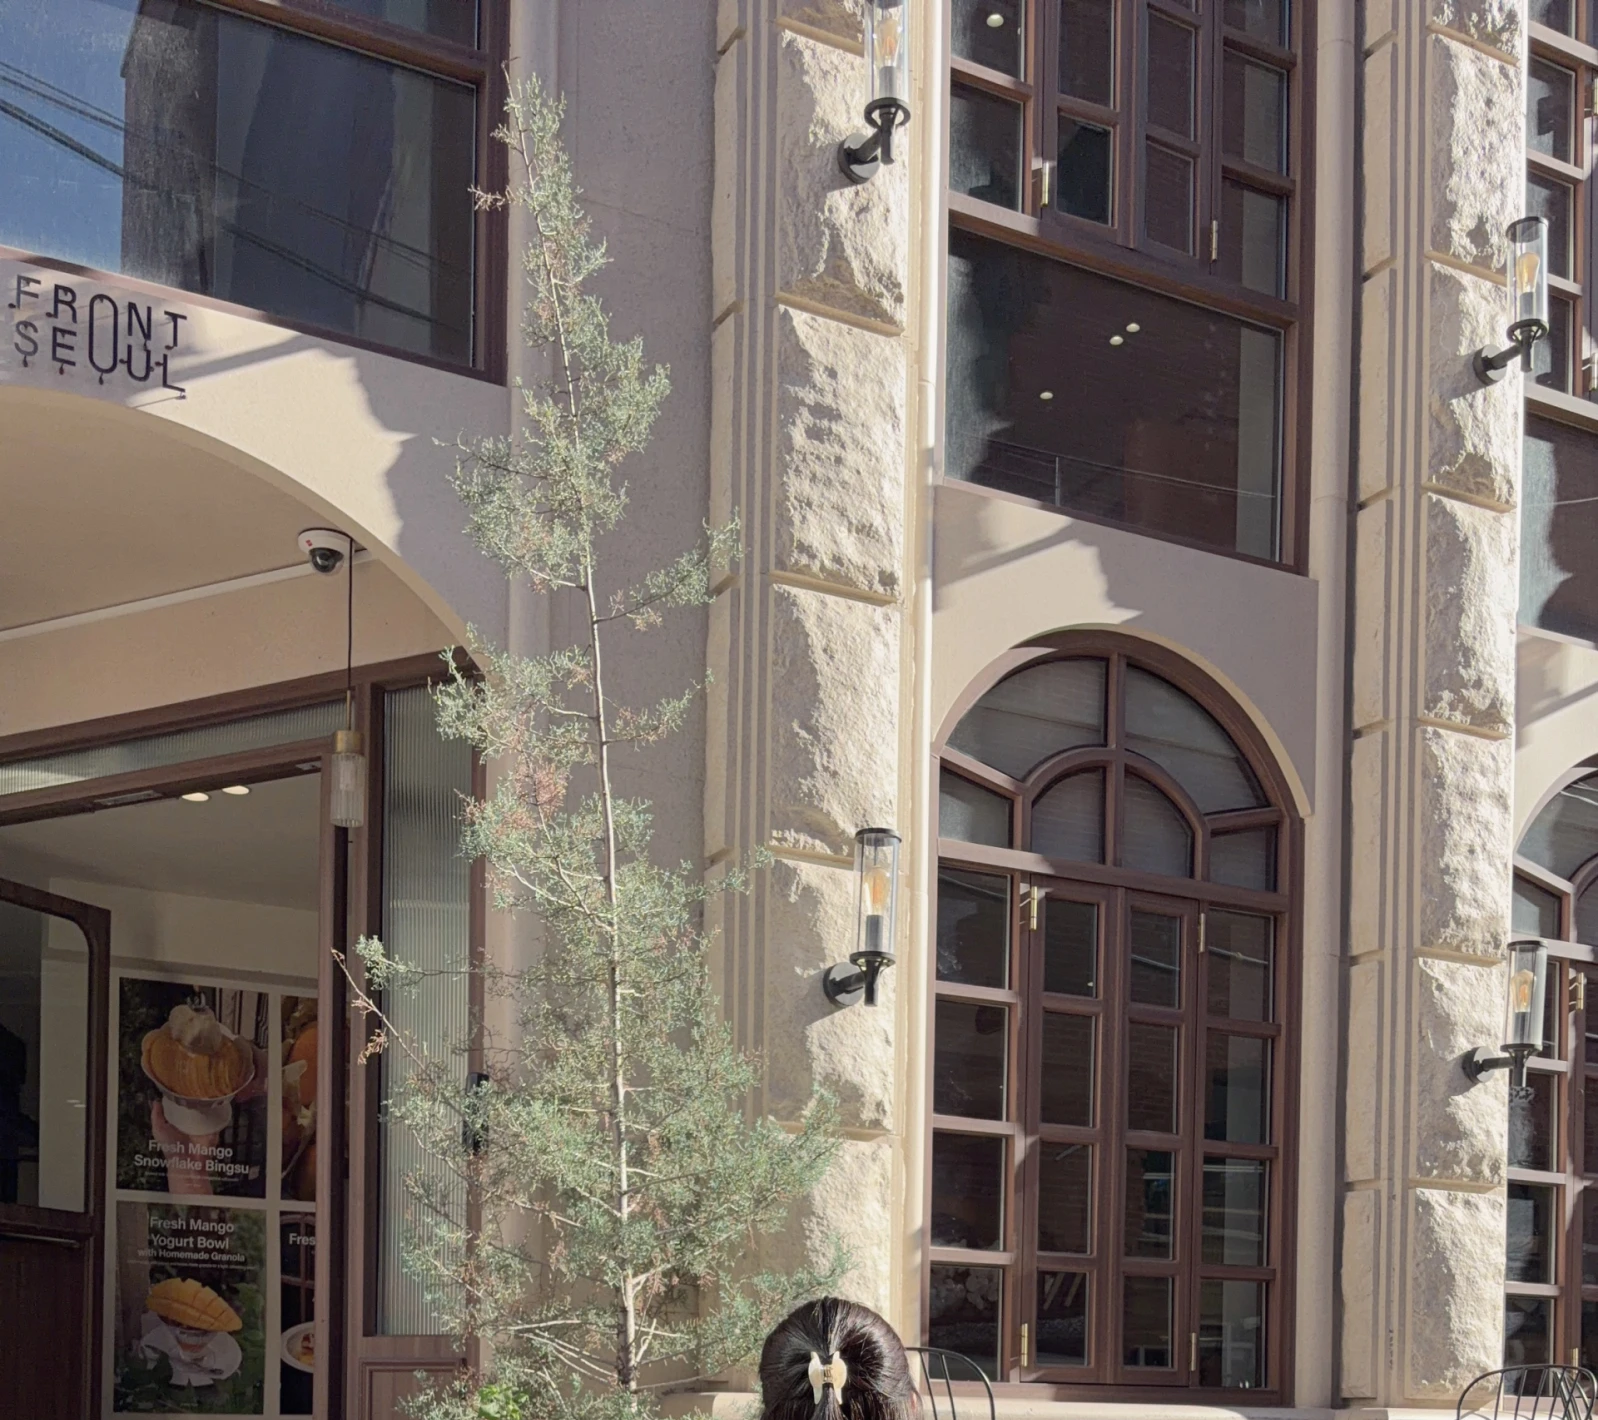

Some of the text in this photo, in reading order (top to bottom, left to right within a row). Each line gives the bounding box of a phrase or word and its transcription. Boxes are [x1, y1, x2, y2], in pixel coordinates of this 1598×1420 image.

[16, 274, 187, 373] FRONT
[14, 294, 186, 393] SEOUL
[148, 1139, 233, 1160] Fresh Mango
[134, 1154, 250, 1175] Snowflake Bingsu
[150, 1216, 235, 1235] Fresh Mango
[151, 1233, 229, 1249] Yogurt Bowl
[137, 1248, 245, 1263] with Homemade Granola
